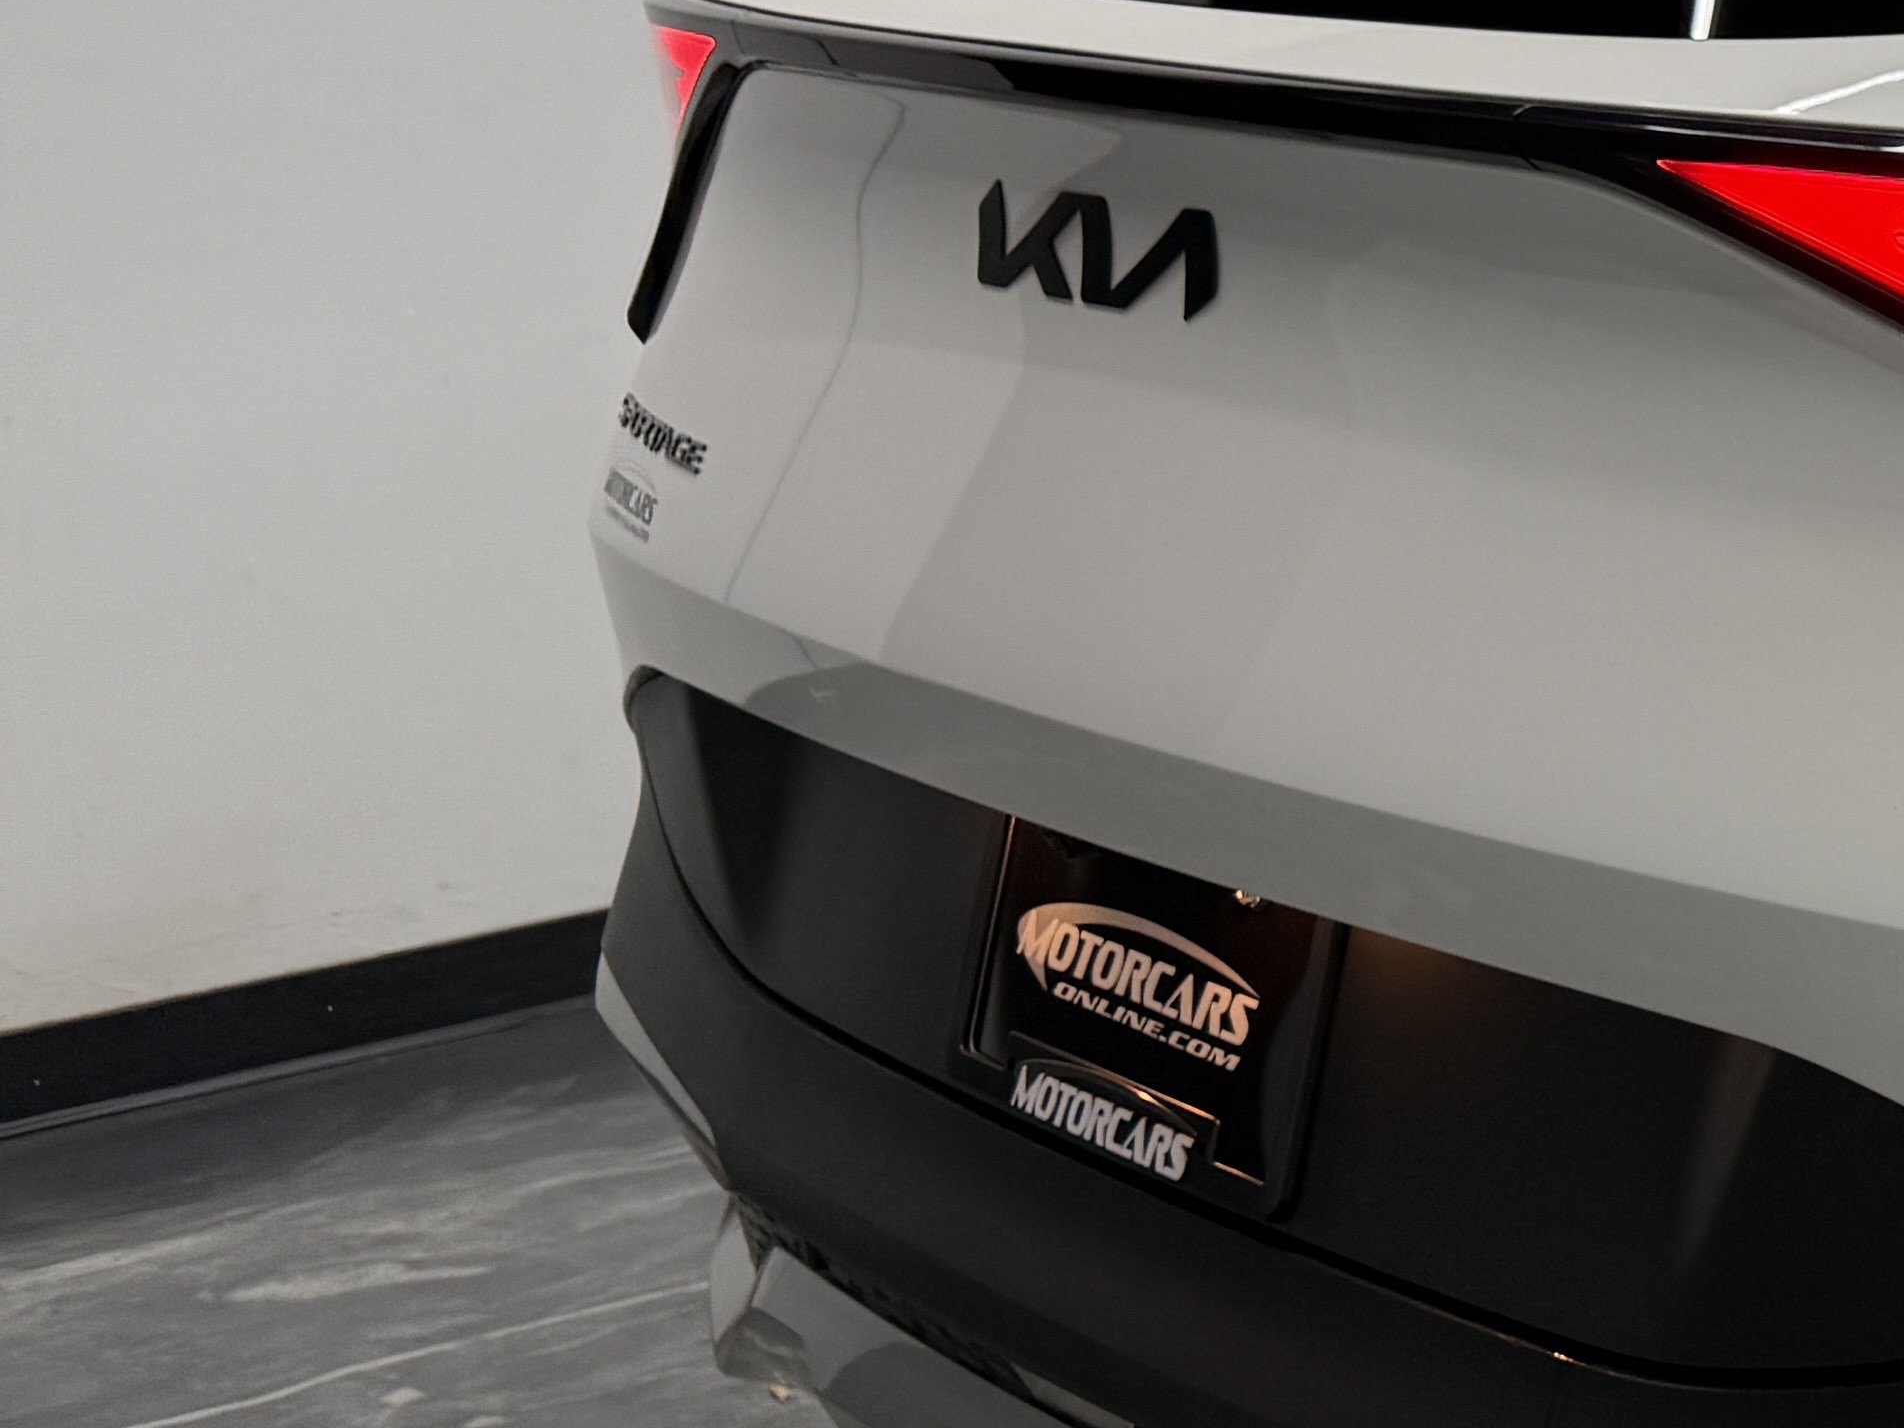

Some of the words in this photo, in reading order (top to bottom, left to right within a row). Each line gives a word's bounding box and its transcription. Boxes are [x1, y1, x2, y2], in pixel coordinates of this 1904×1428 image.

[977, 178, 1220, 322] KIA
[1016, 908, 1259, 1047] MOTORCARS
[1053, 980, 1242, 1072] ONLINE.COM
[1010, 1065, 1195, 1182] MOTORCARS
